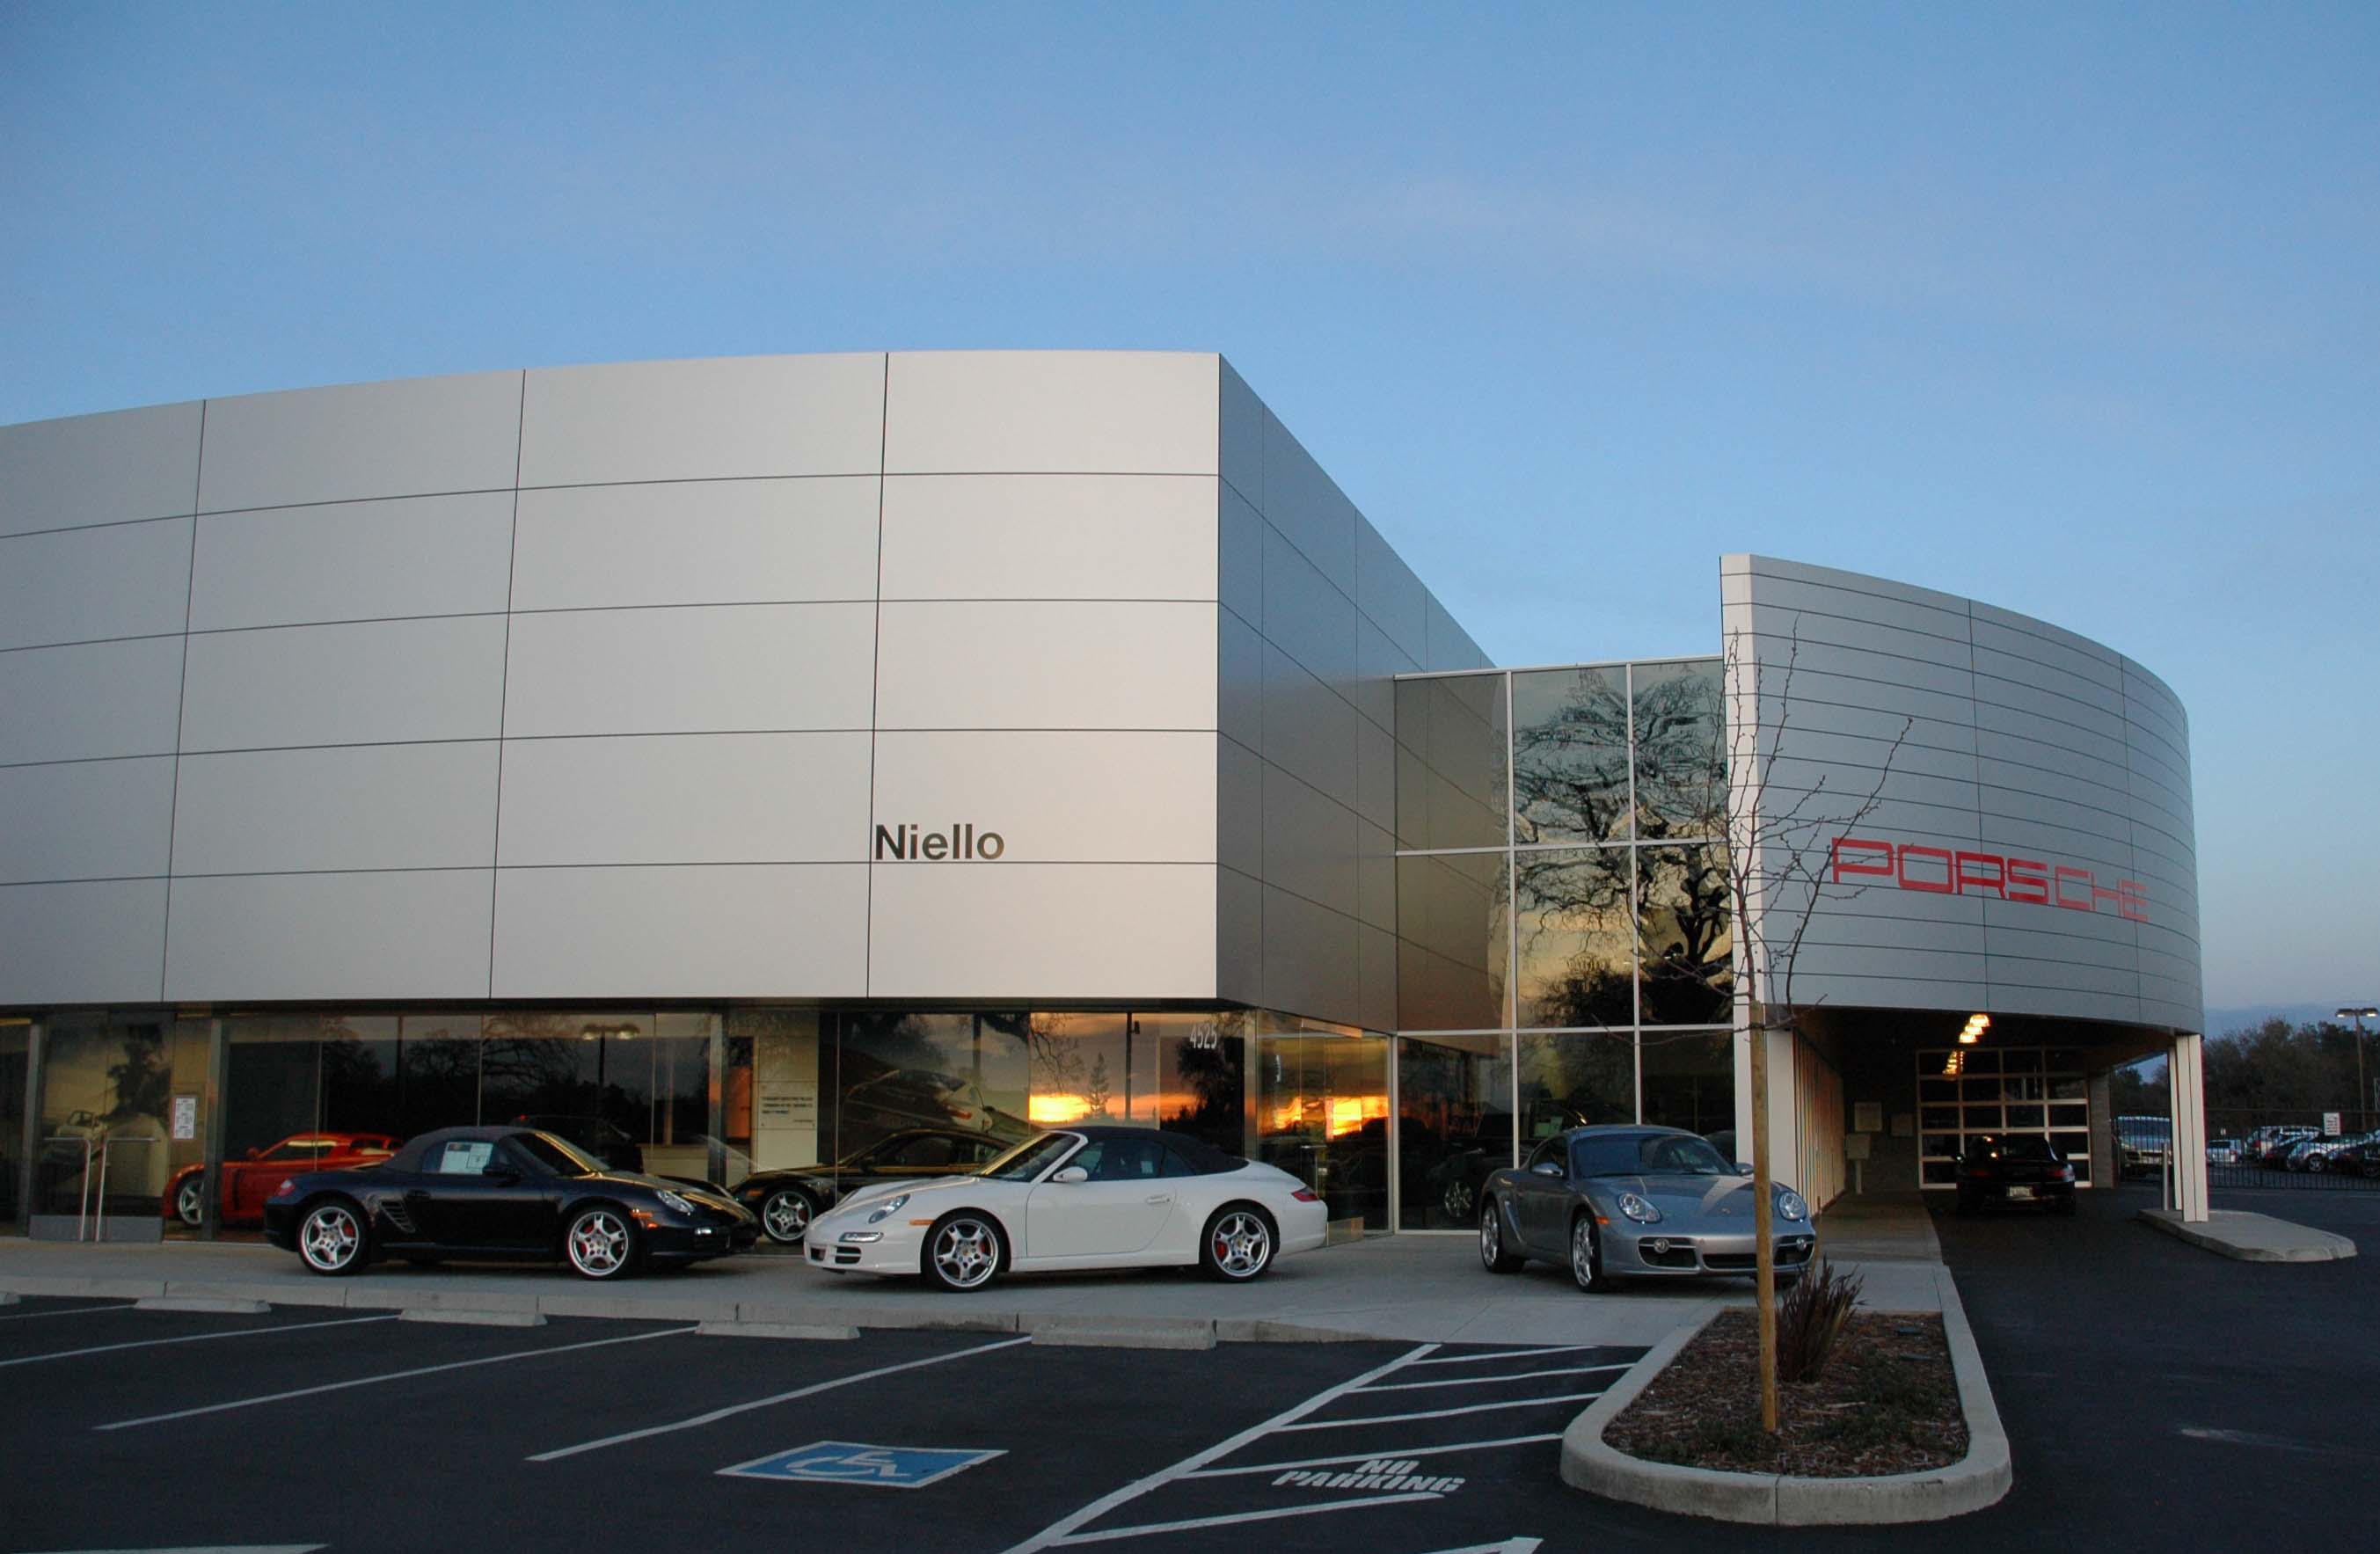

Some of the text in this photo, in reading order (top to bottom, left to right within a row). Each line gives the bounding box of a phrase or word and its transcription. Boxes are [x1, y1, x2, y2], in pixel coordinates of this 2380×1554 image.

[875, 824, 1004, 860] Niello
[1831, 837, 2149, 923] PORSCHE
[1189, 1023, 1217, 1049] 4525
[1355, 1459, 1420, 1475] NO
[1271, 1470, 1466, 1492] PARKING
